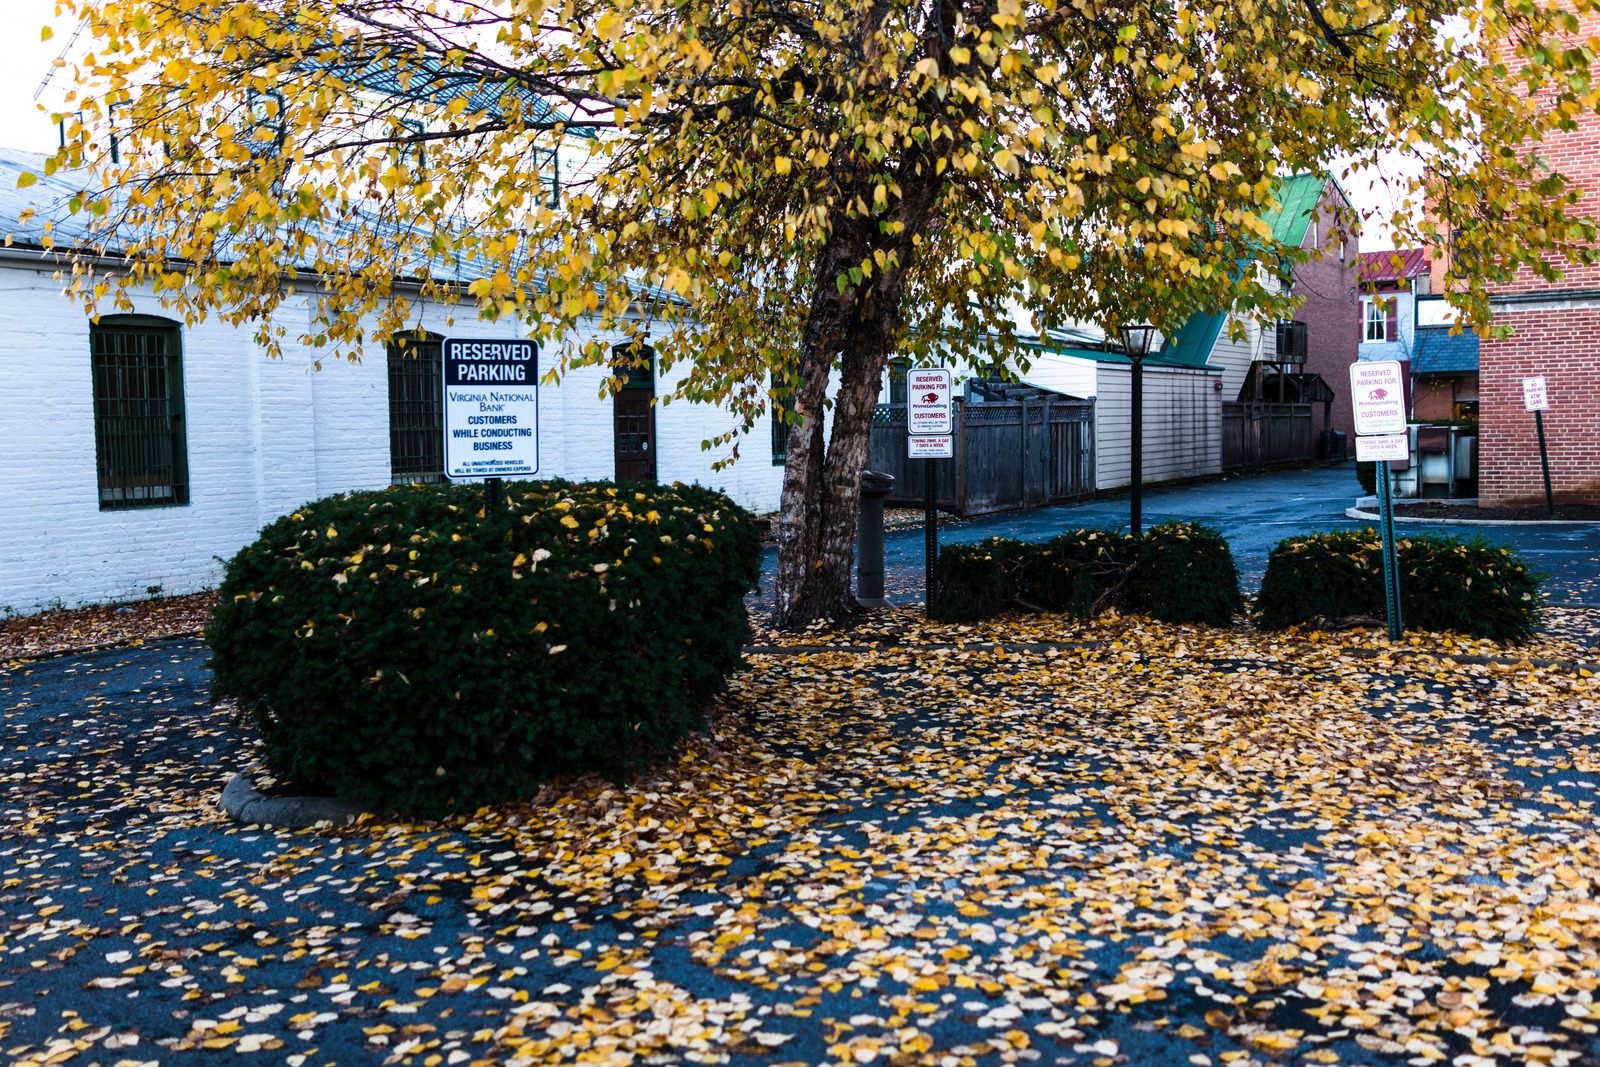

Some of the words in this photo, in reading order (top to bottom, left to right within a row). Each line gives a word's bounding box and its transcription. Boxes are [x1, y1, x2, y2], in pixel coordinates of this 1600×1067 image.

[451, 343, 532, 360] RESERVED
[458, 364, 526, 381] PARKING
[468, 416, 517, 424] CUSTOMERS
[453, 429, 478, 438] WHILE
[481, 428, 532, 437] CONDUCTING
[473, 441, 512, 451] BUSINESS
